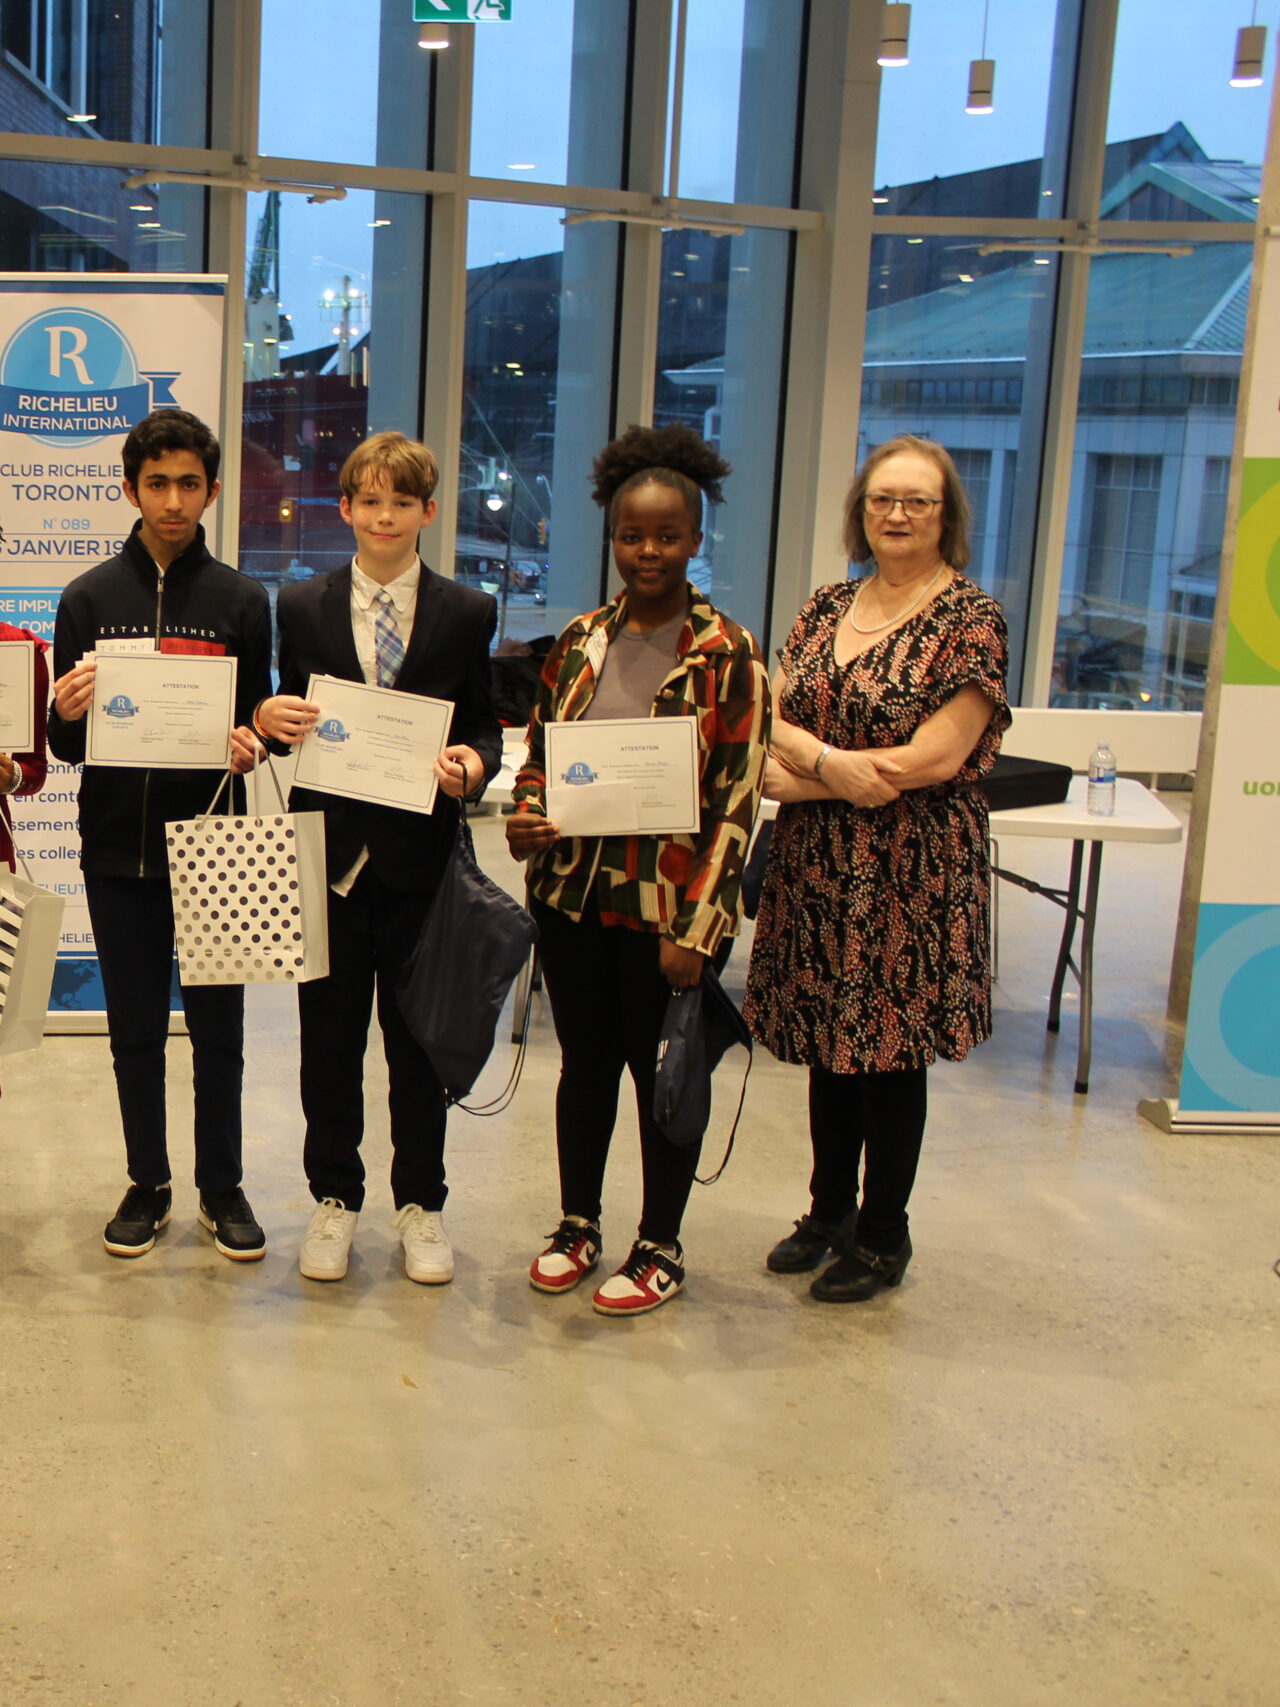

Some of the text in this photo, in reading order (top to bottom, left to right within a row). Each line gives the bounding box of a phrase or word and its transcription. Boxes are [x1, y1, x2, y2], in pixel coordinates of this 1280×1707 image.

[44, 325, 94, 385] R
[18, 394, 118, 412] RICHELIEU
[3, 413, 133, 430] INTERNATIONAL
[0, 464, 44, 477] CLUB
[11, 484, 122, 501] TORONTO
[61, 518, 91, 530] 089
[7, 539, 100, 556] JANVIER
[100, 625, 216, 638] ESTABLISHED
